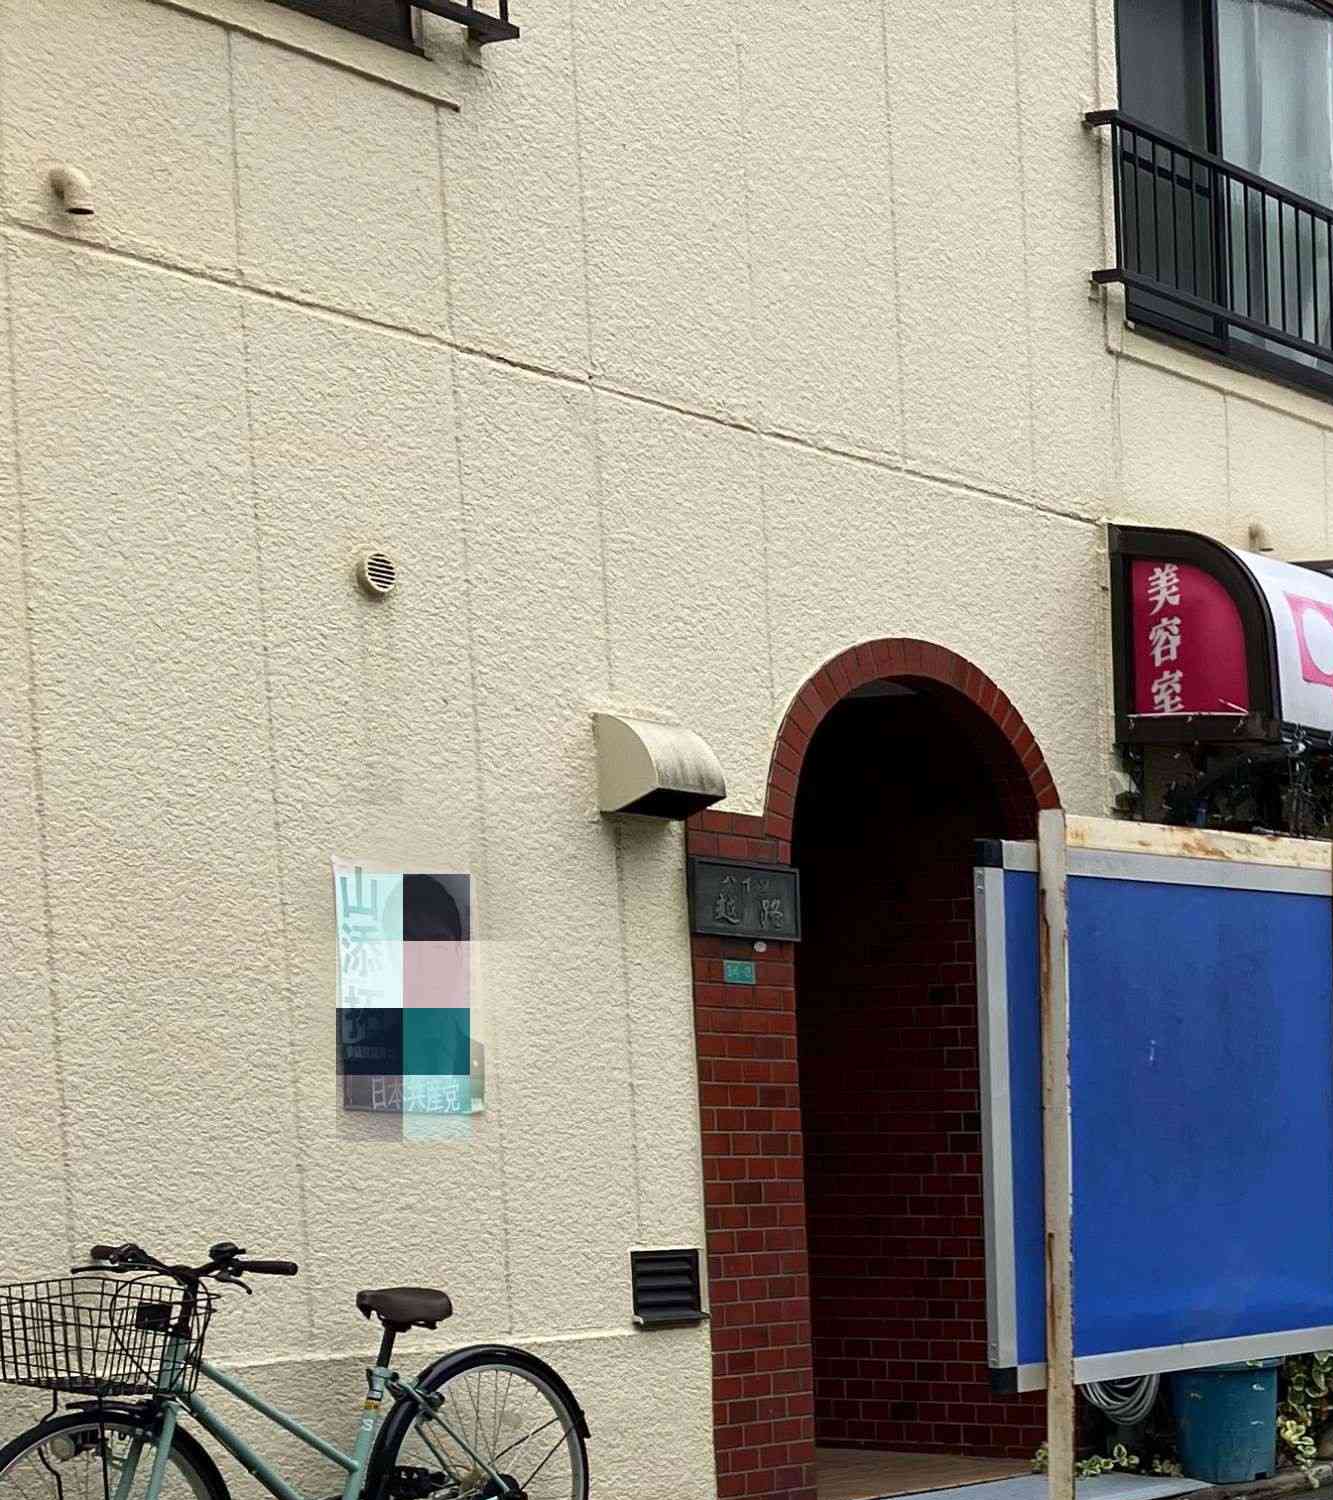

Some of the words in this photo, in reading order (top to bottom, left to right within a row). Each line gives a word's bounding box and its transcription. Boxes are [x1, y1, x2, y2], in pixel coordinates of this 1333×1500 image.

[1147, 563, 1185, 713] 美容室
[370, 1078, 460, 1112] 日本共産党
